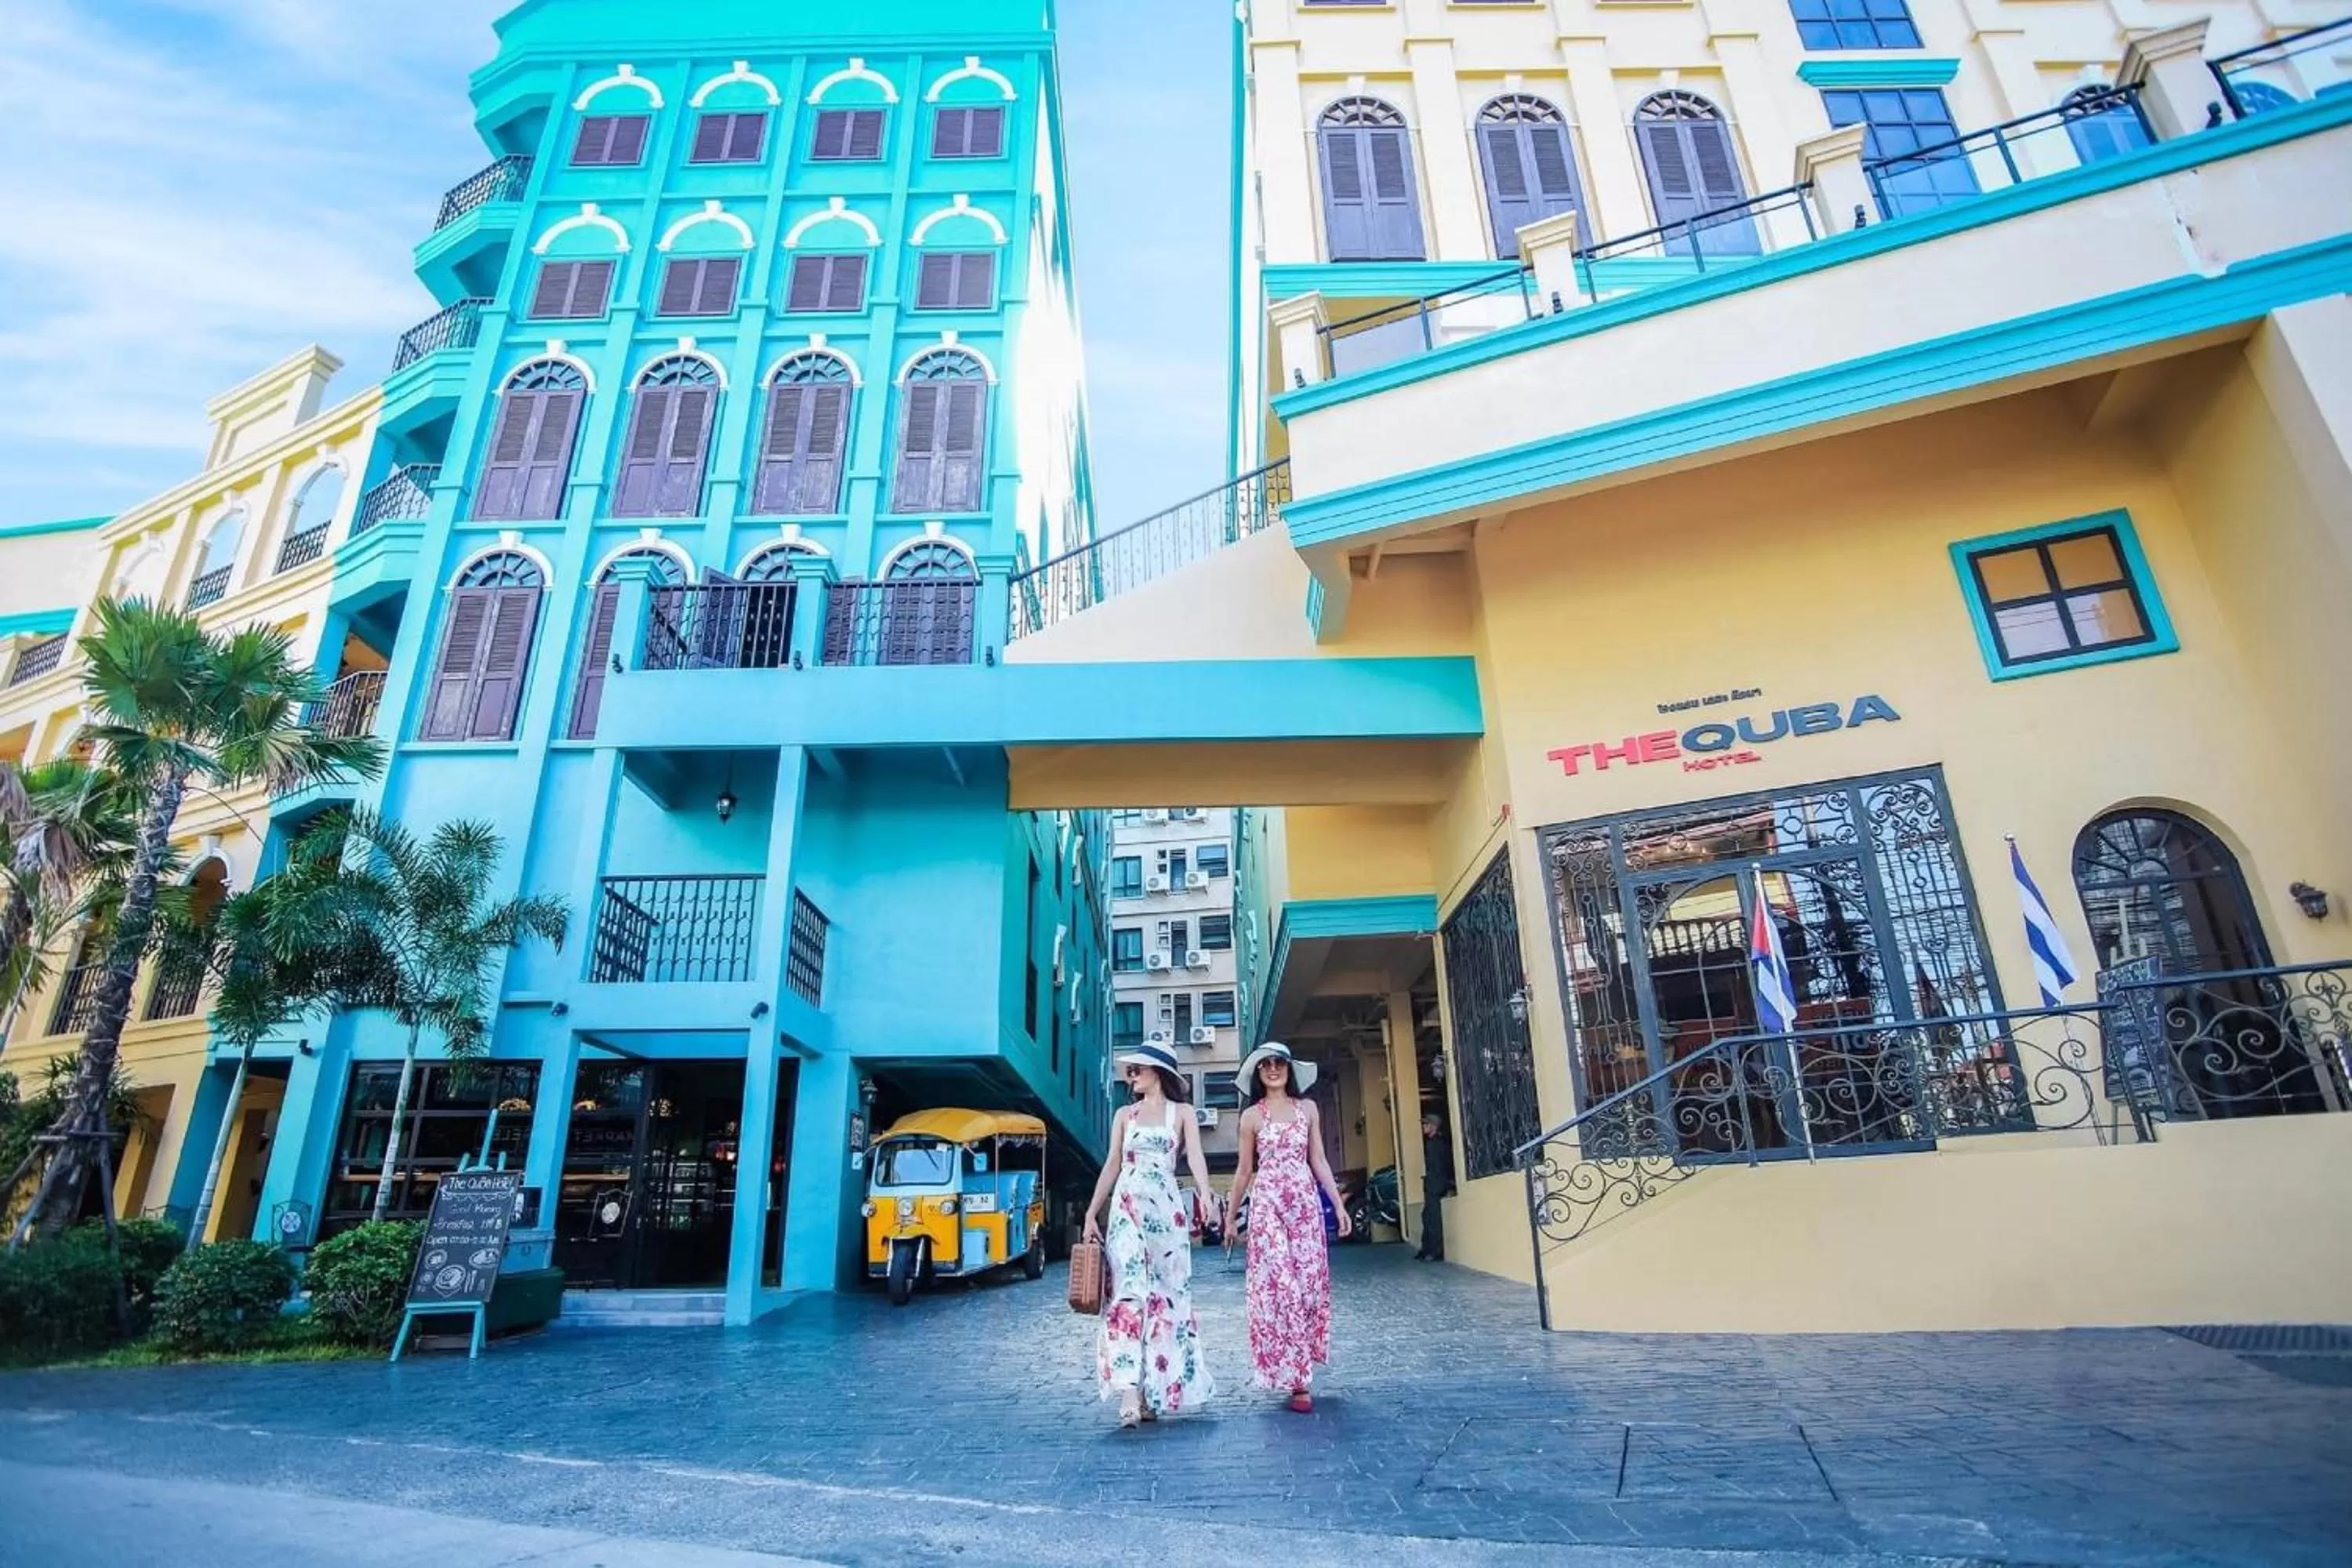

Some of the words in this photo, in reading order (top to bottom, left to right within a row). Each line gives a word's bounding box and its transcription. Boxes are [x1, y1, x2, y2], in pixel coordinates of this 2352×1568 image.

[1547, 729, 1681, 776] THE
[1681, 695, 1901, 753] QUBA
[1683, 750, 1762, 773] HOTEL
[449, 1176, 466, 1189] The
